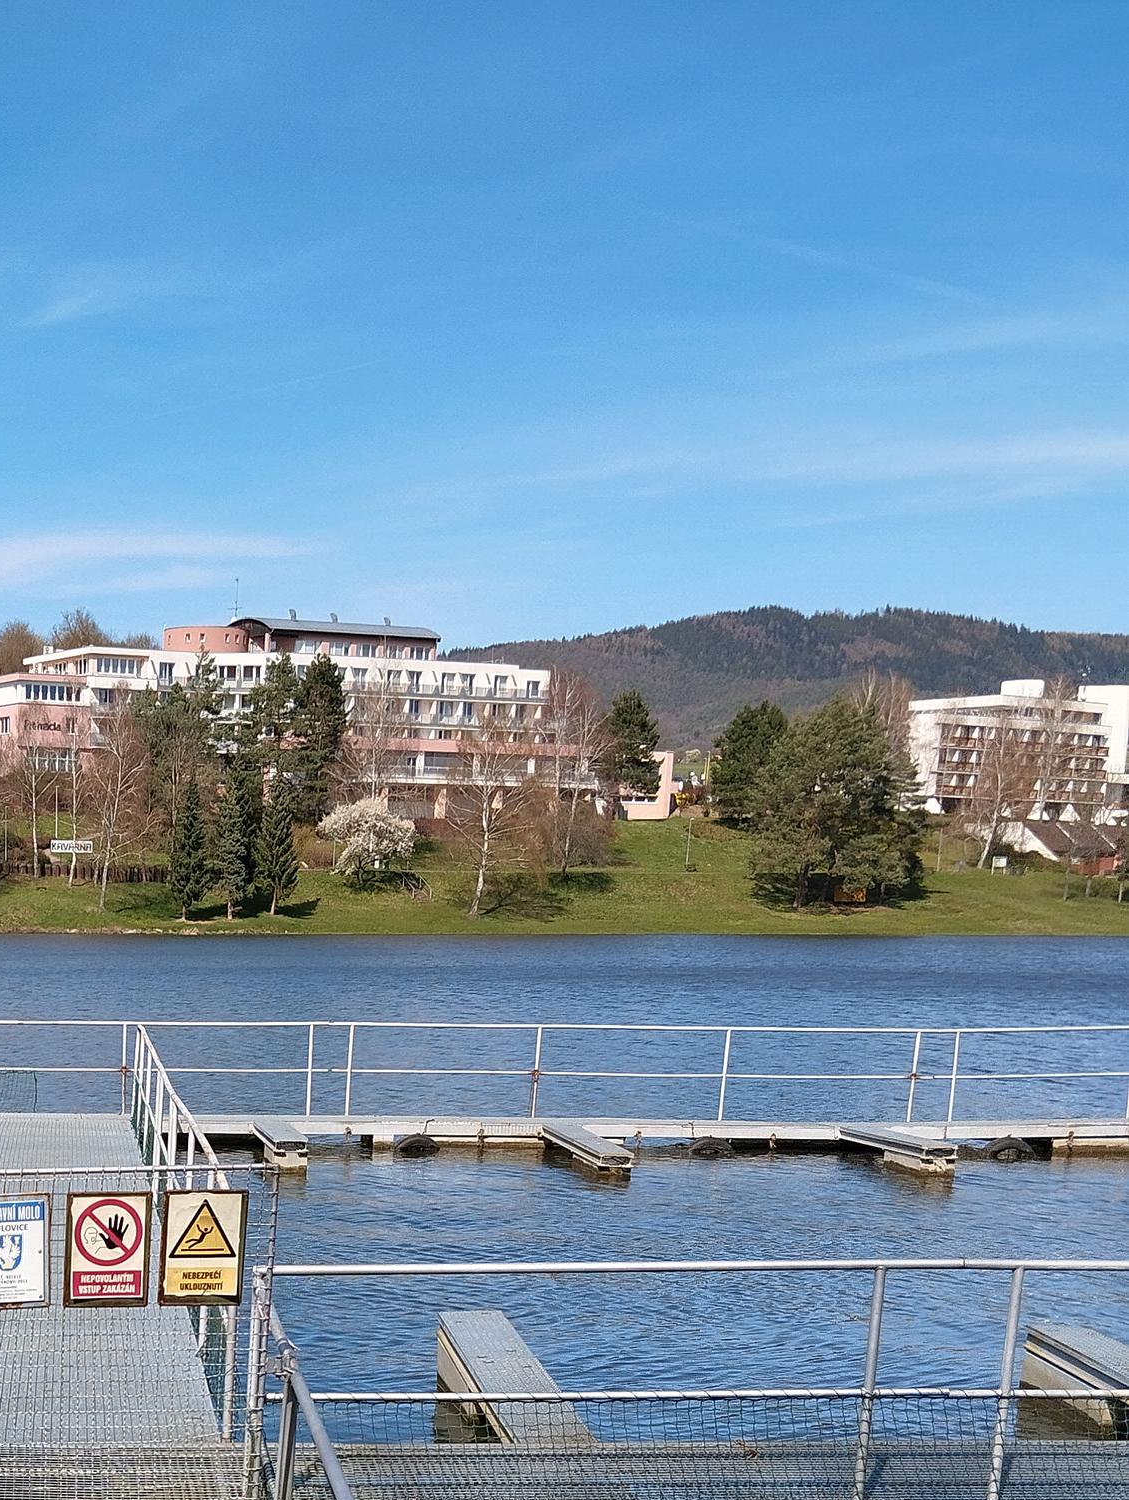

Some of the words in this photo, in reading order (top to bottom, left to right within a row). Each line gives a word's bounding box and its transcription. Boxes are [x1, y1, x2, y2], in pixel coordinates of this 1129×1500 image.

[18, 1205, 40, 1220] MOLO
[81, 1272, 134, 1283] NEPOVOLANÝM
[182, 1270, 222, 1280] NEBEZPEČÍ
[79, 1284, 101, 1294] VSTUP
[102, 1283, 135, 1293] ZAKÁZÁN
[179, 1281, 223, 1290] UKLOUZNUTÍ
